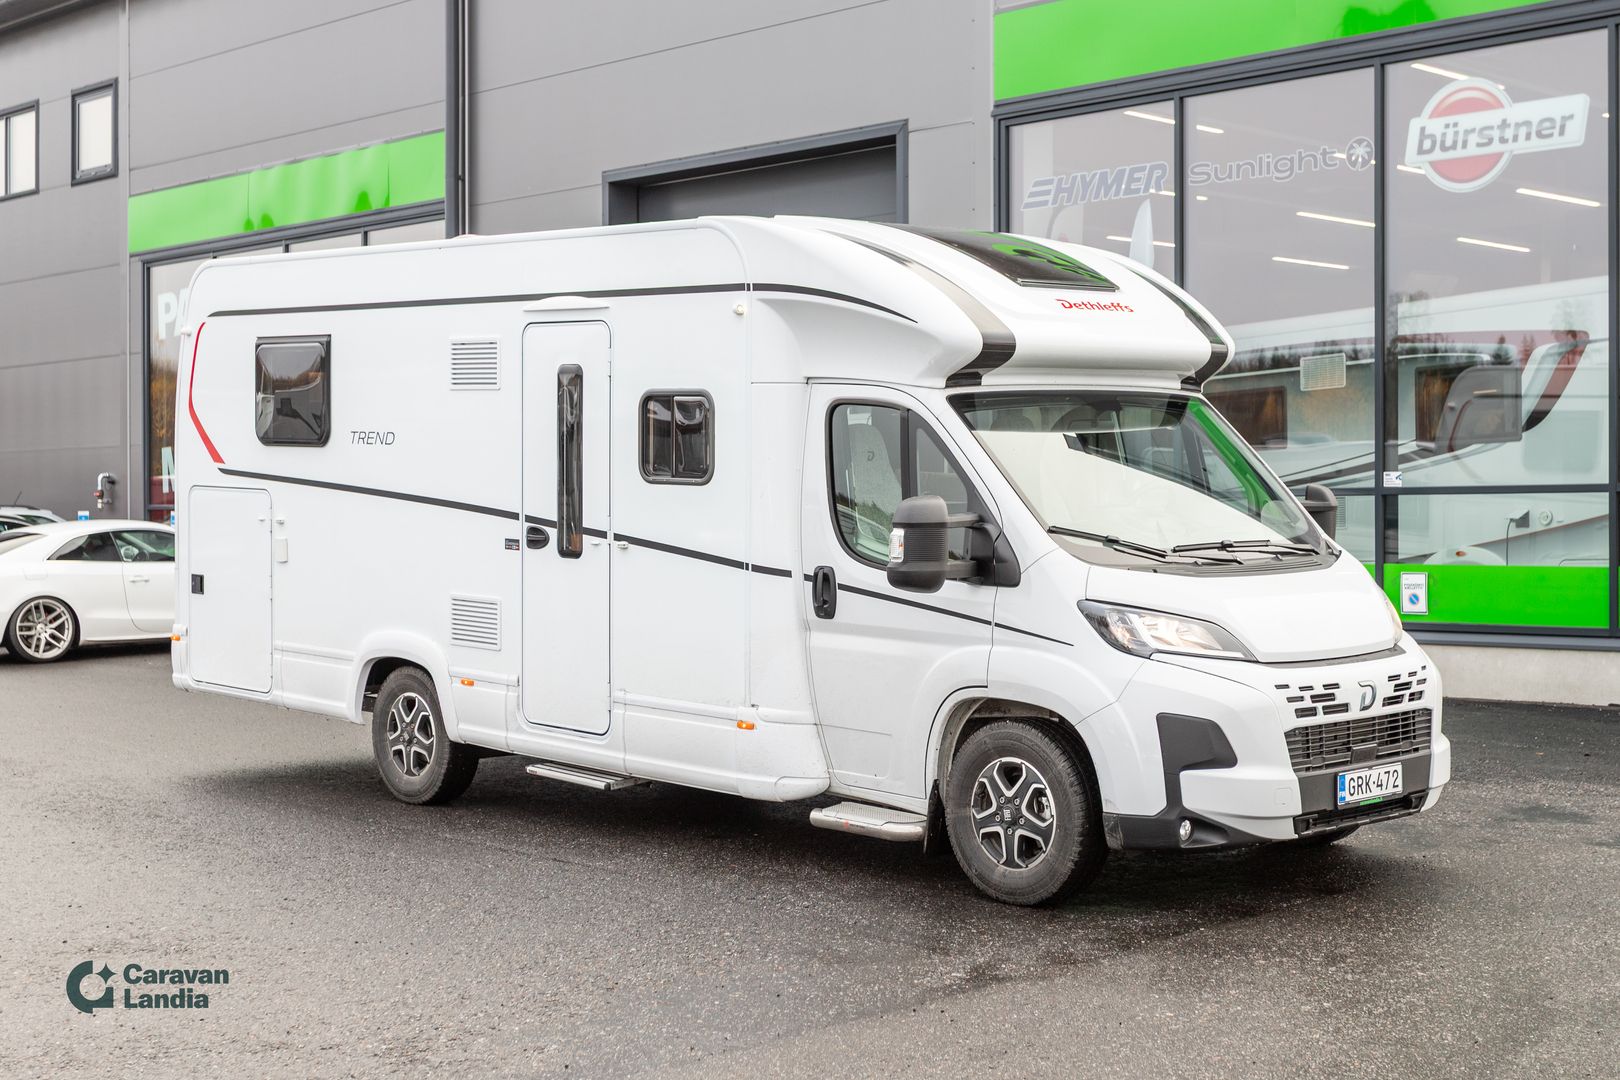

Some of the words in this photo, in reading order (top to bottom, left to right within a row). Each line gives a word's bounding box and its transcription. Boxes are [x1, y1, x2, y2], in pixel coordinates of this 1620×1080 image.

[1416, 112, 1575, 156] bürstner
[1189, 146, 1339, 185] Sunlight
[1050, 161, 1169, 207] HYMER
[1055, 298, 1135, 313] Dethleffs
[350, 430, 396, 446] TREND
[1348, 769, 1400, 797] GRK-472
